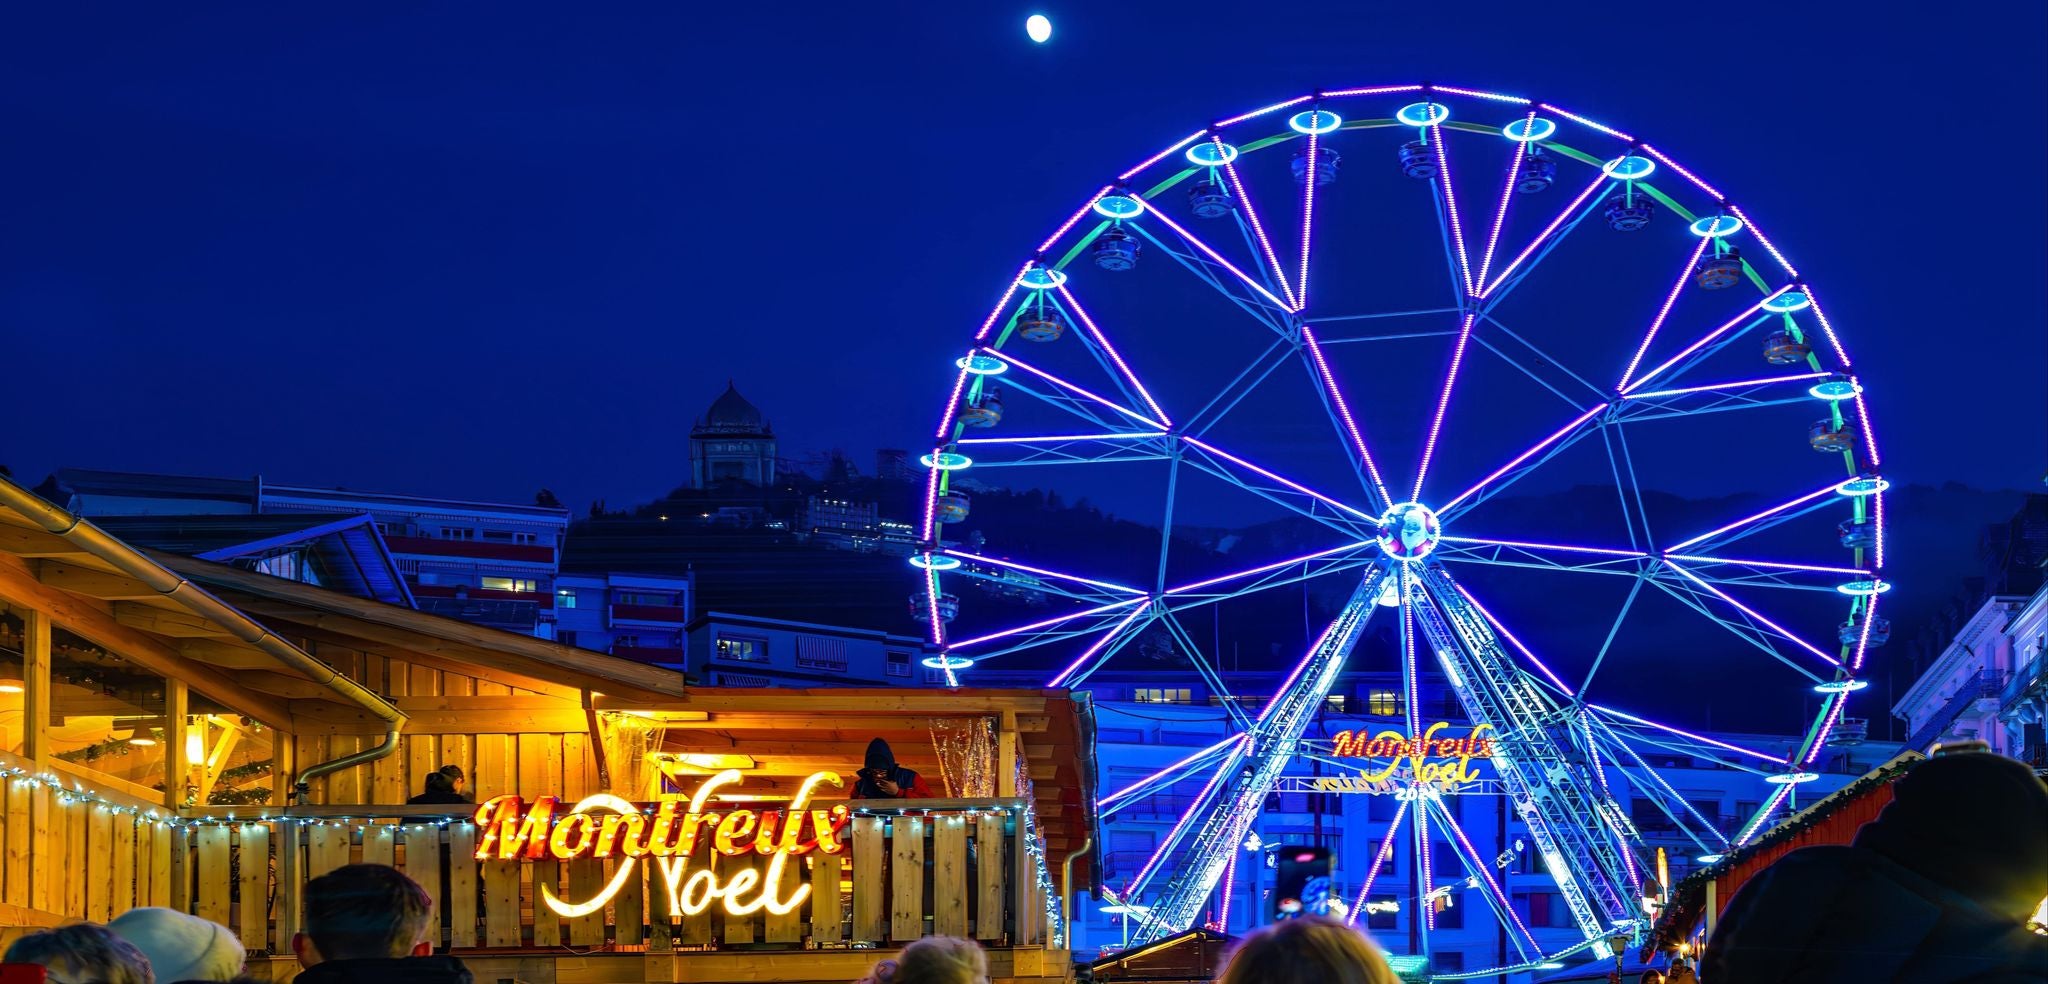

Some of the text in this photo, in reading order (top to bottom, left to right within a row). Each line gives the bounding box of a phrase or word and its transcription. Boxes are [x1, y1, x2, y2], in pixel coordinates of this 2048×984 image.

[1332, 730, 1495, 758] Montreux
[474, 794, 852, 860] Montreux
[541, 769, 847, 918] Noel
